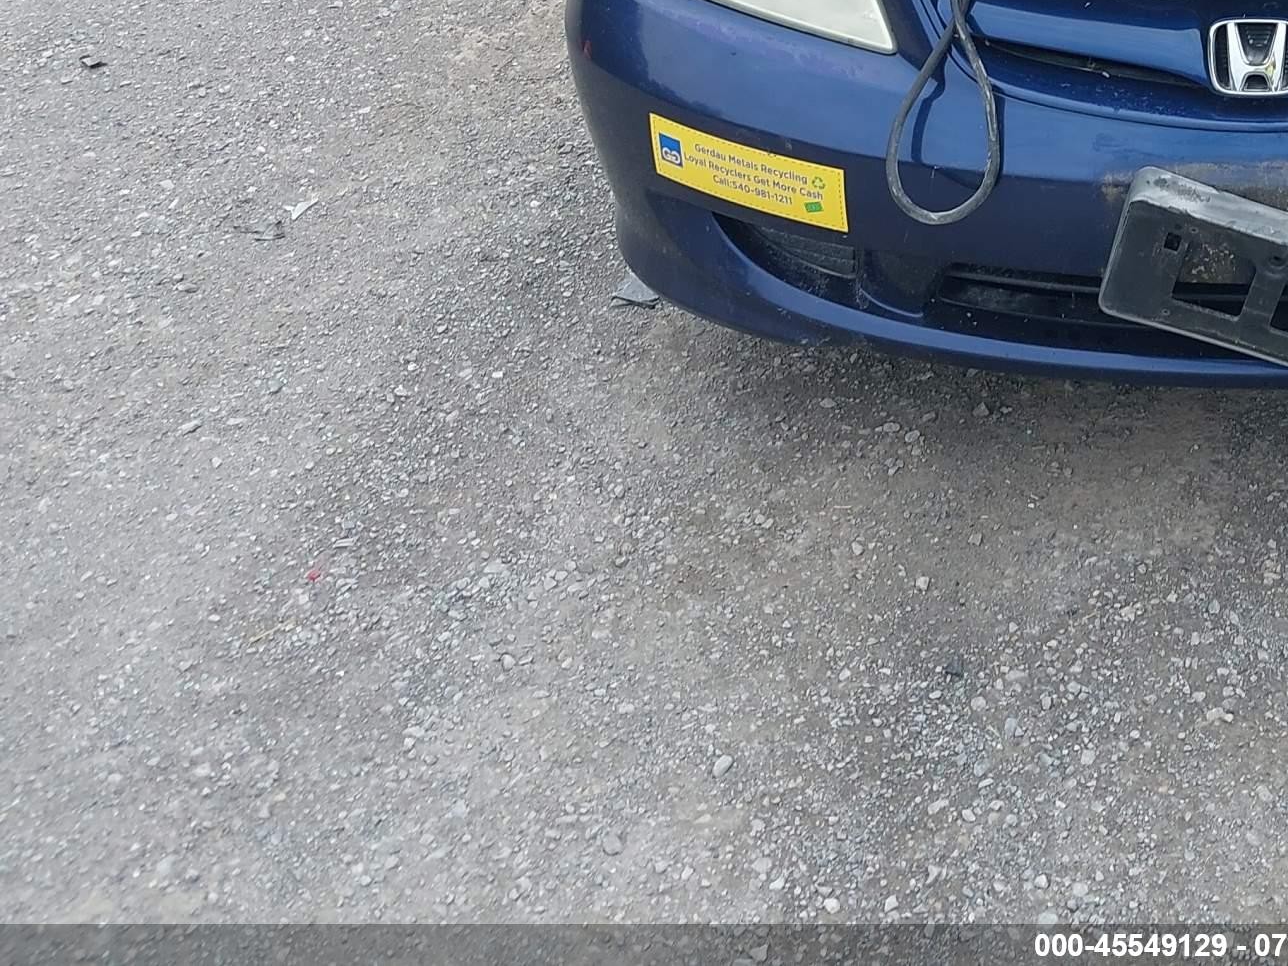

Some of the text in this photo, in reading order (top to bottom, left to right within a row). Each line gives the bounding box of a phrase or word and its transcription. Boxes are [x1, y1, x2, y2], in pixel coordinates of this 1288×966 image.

[684, 151, 823, 201] Loyal Recyclers Get More Cash
[694, 143, 808, 185] Gerdau Metals Recycling
